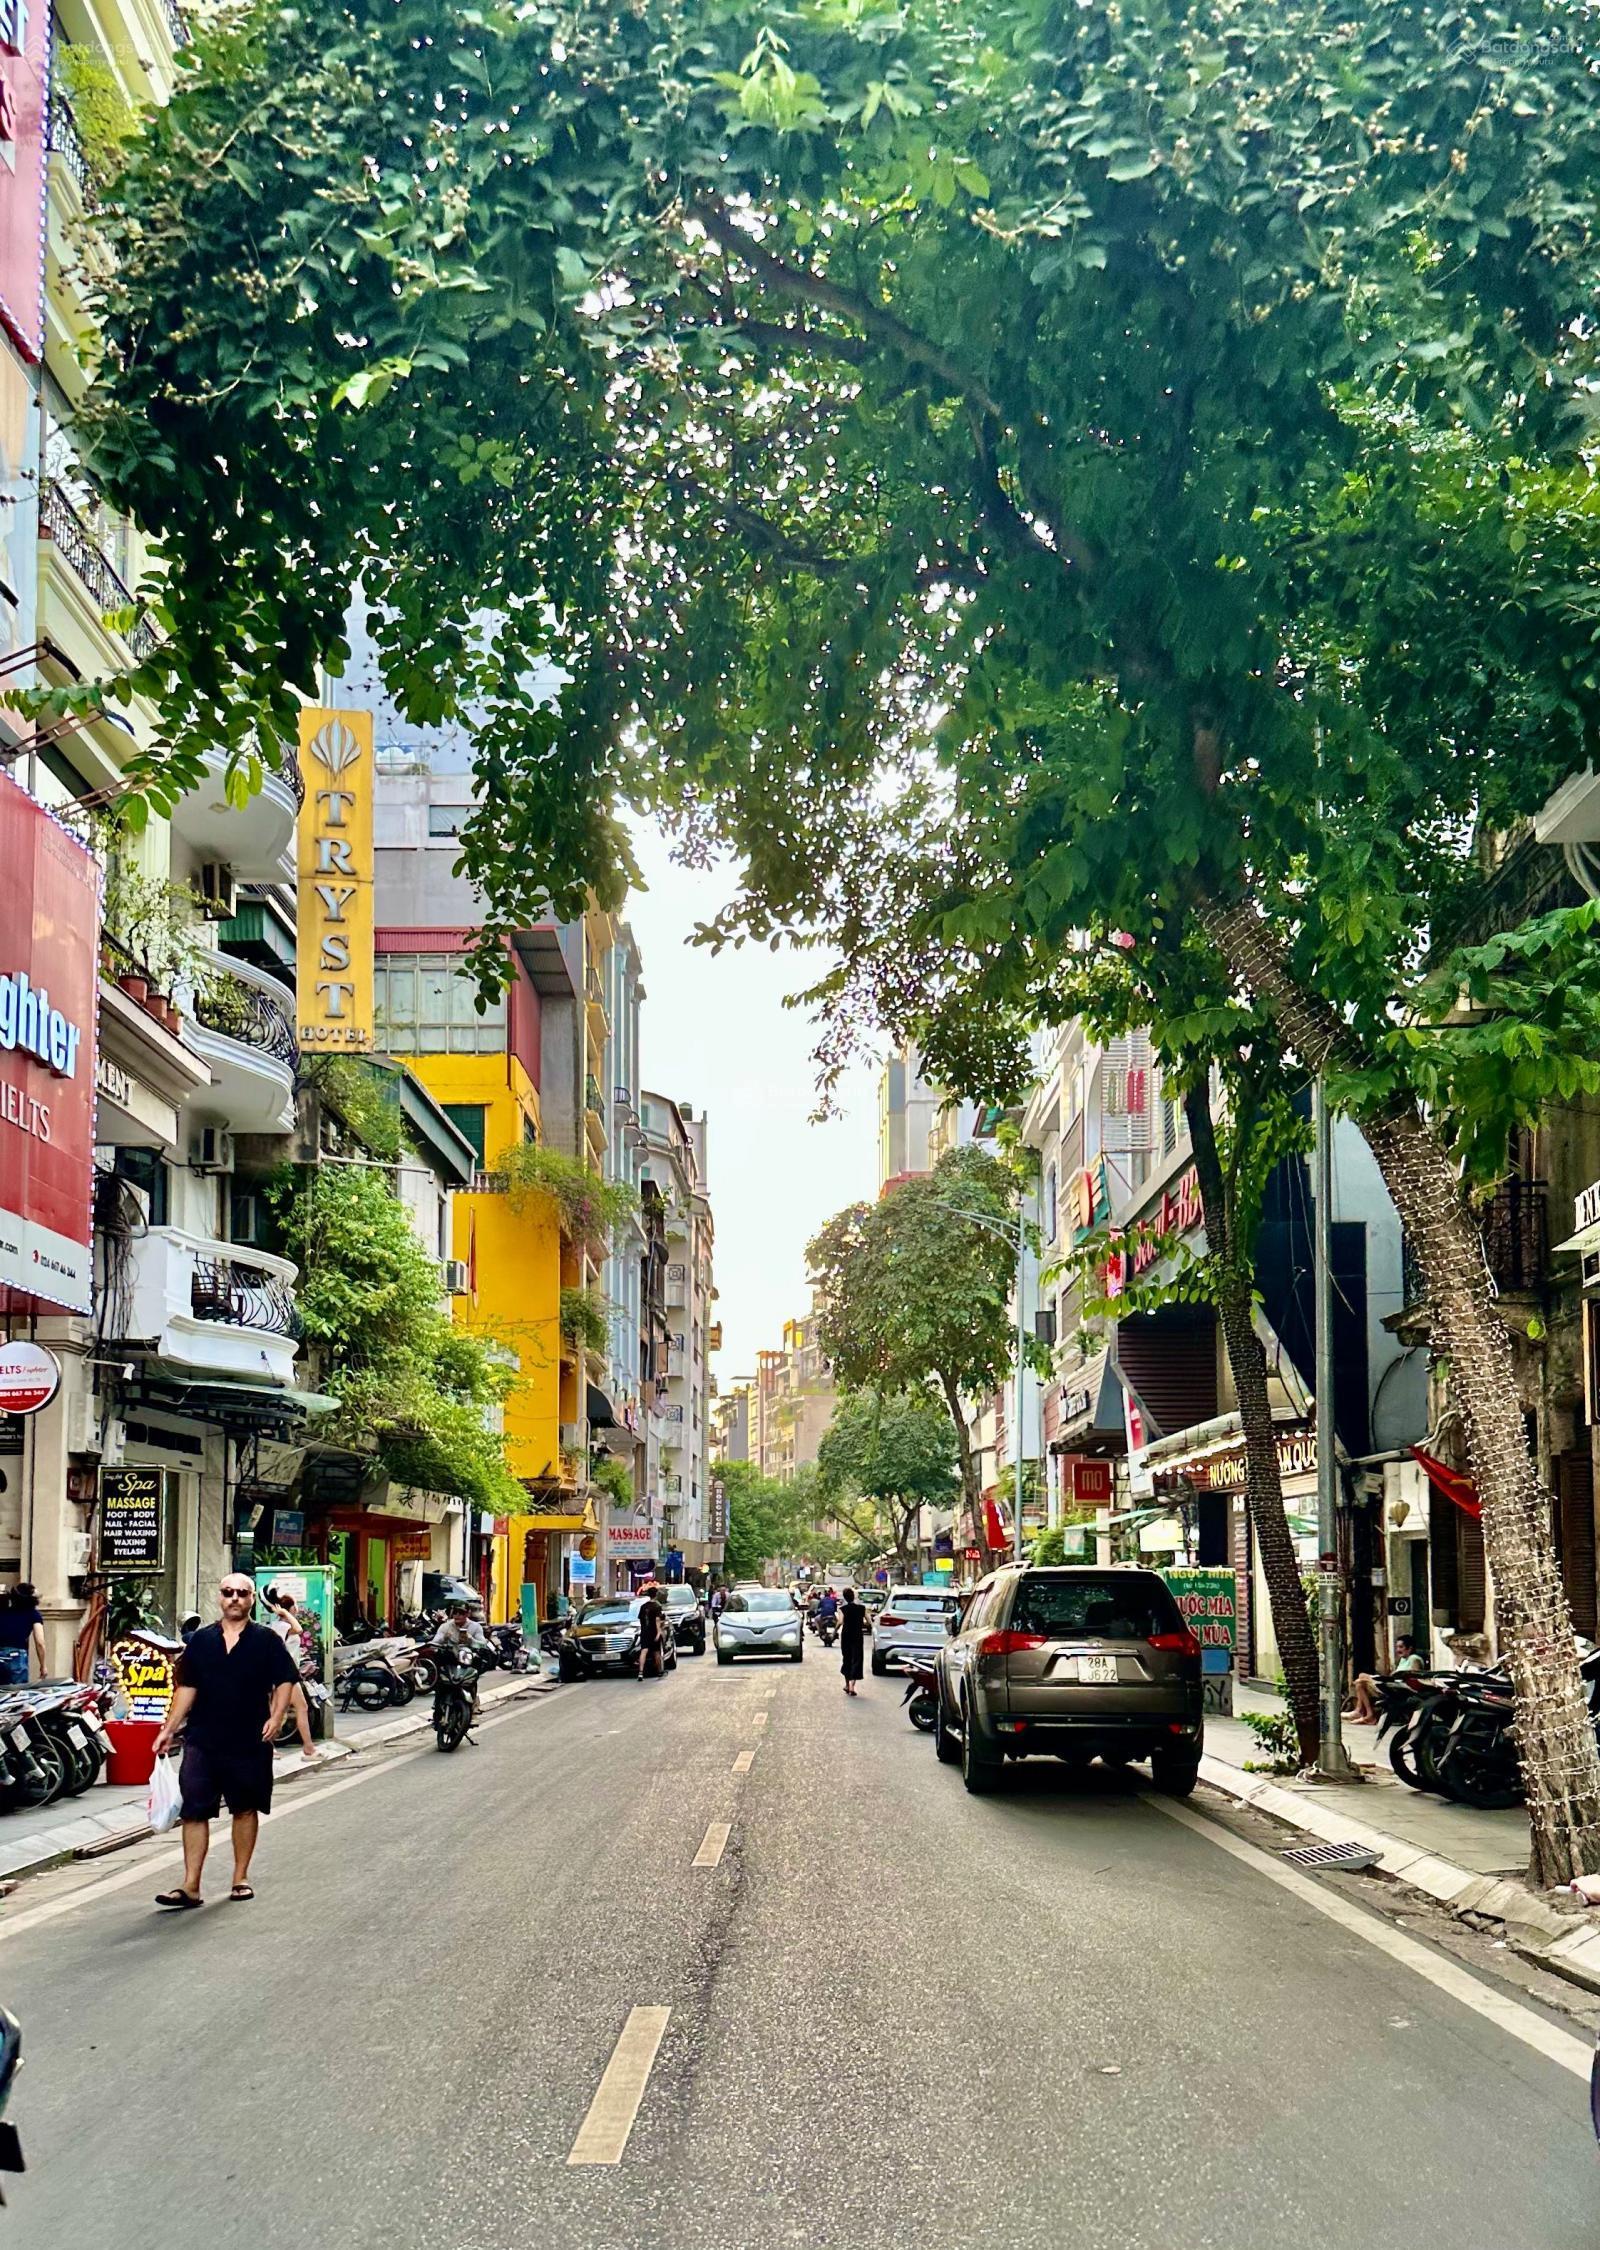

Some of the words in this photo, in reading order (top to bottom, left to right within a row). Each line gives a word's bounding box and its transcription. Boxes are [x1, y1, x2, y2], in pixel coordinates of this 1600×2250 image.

[314, 790, 356, 1019] TRYST
[0, 971, 80, 1079] ghter
[300, 1025, 367, 1045] HOTEL
[118, 1472, 156, 1496] Spa
[107, 1497, 156, 1509] MASSAGE
[113, 1538, 147, 1546] WAXING
[609, 1527, 652, 1540] MASSAGE
[1087, 1657, 1108, 1669] 28A
[124, 1663, 166, 1686] Spa
